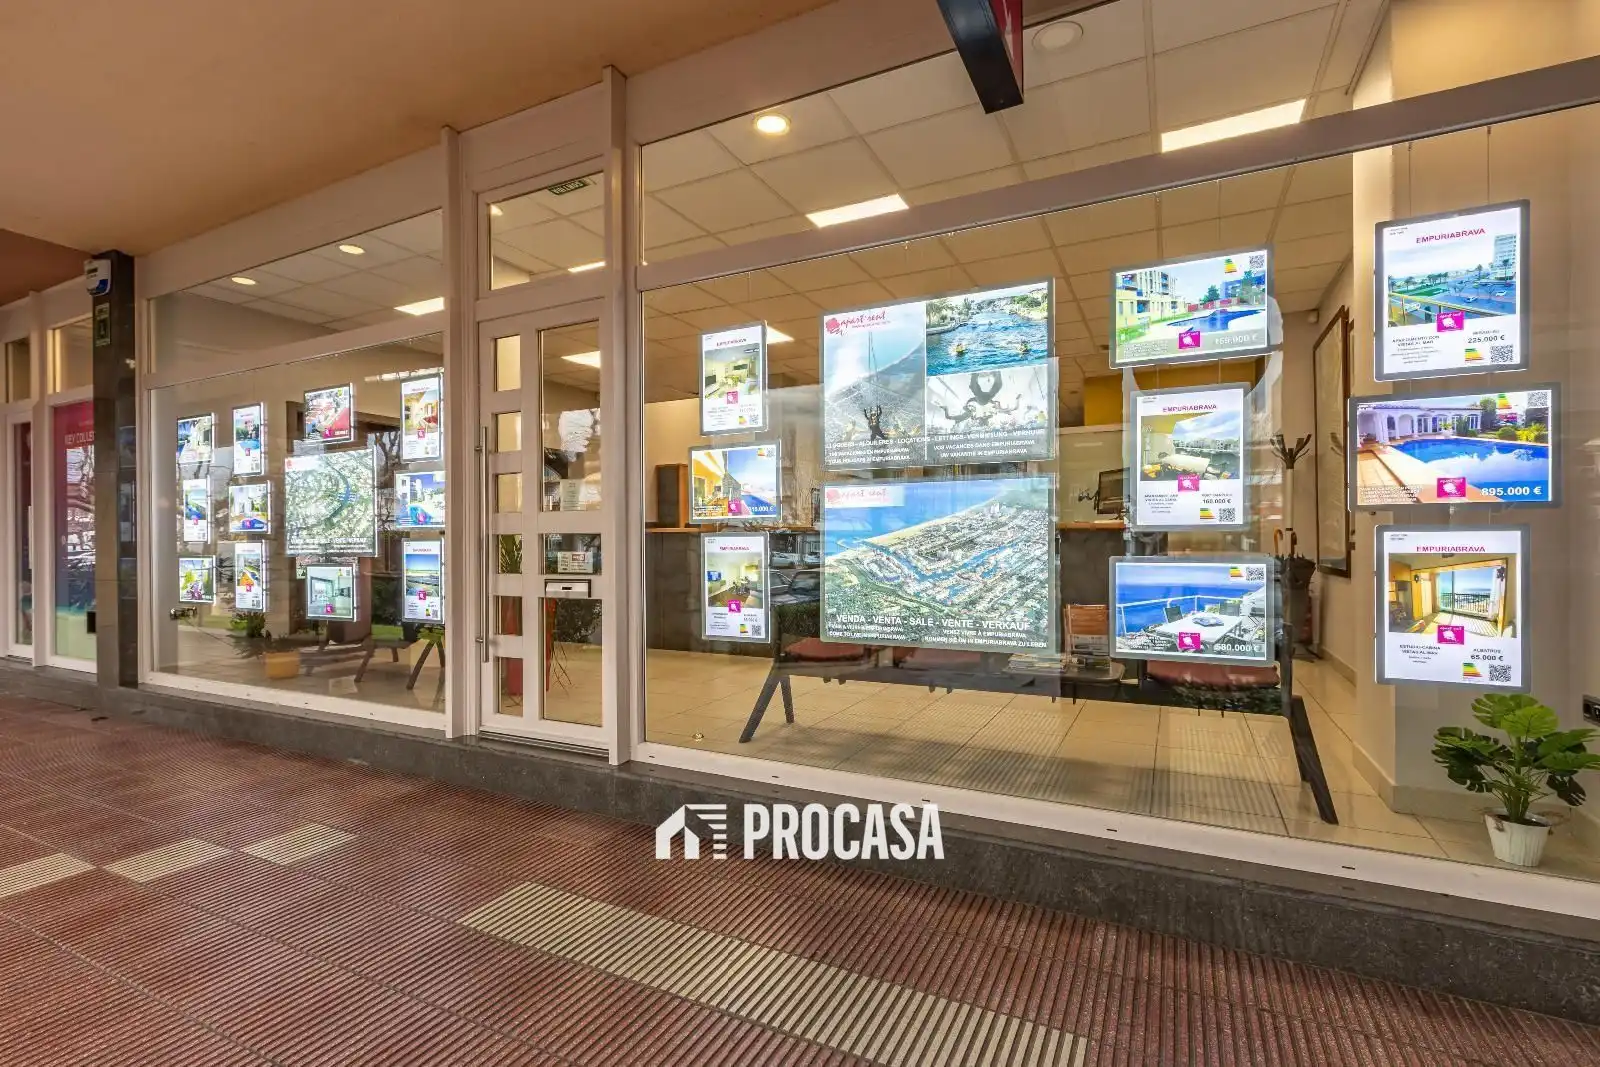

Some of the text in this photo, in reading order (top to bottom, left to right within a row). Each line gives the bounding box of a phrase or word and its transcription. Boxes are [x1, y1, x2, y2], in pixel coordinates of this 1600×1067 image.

[1416, 228, 1486, 244] EMPURIABRAVA
[1468, 335, 1498, 344] 225.000
[1162, 404, 1217, 412] EMPURIABRAVA
[897, 436, 930, 445] LOCATIONS
[1481, 486, 1542, 496] 895.000 €
[836, 614, 1032, 631] VENDA VENTA SALE VENTE VERKAUF
